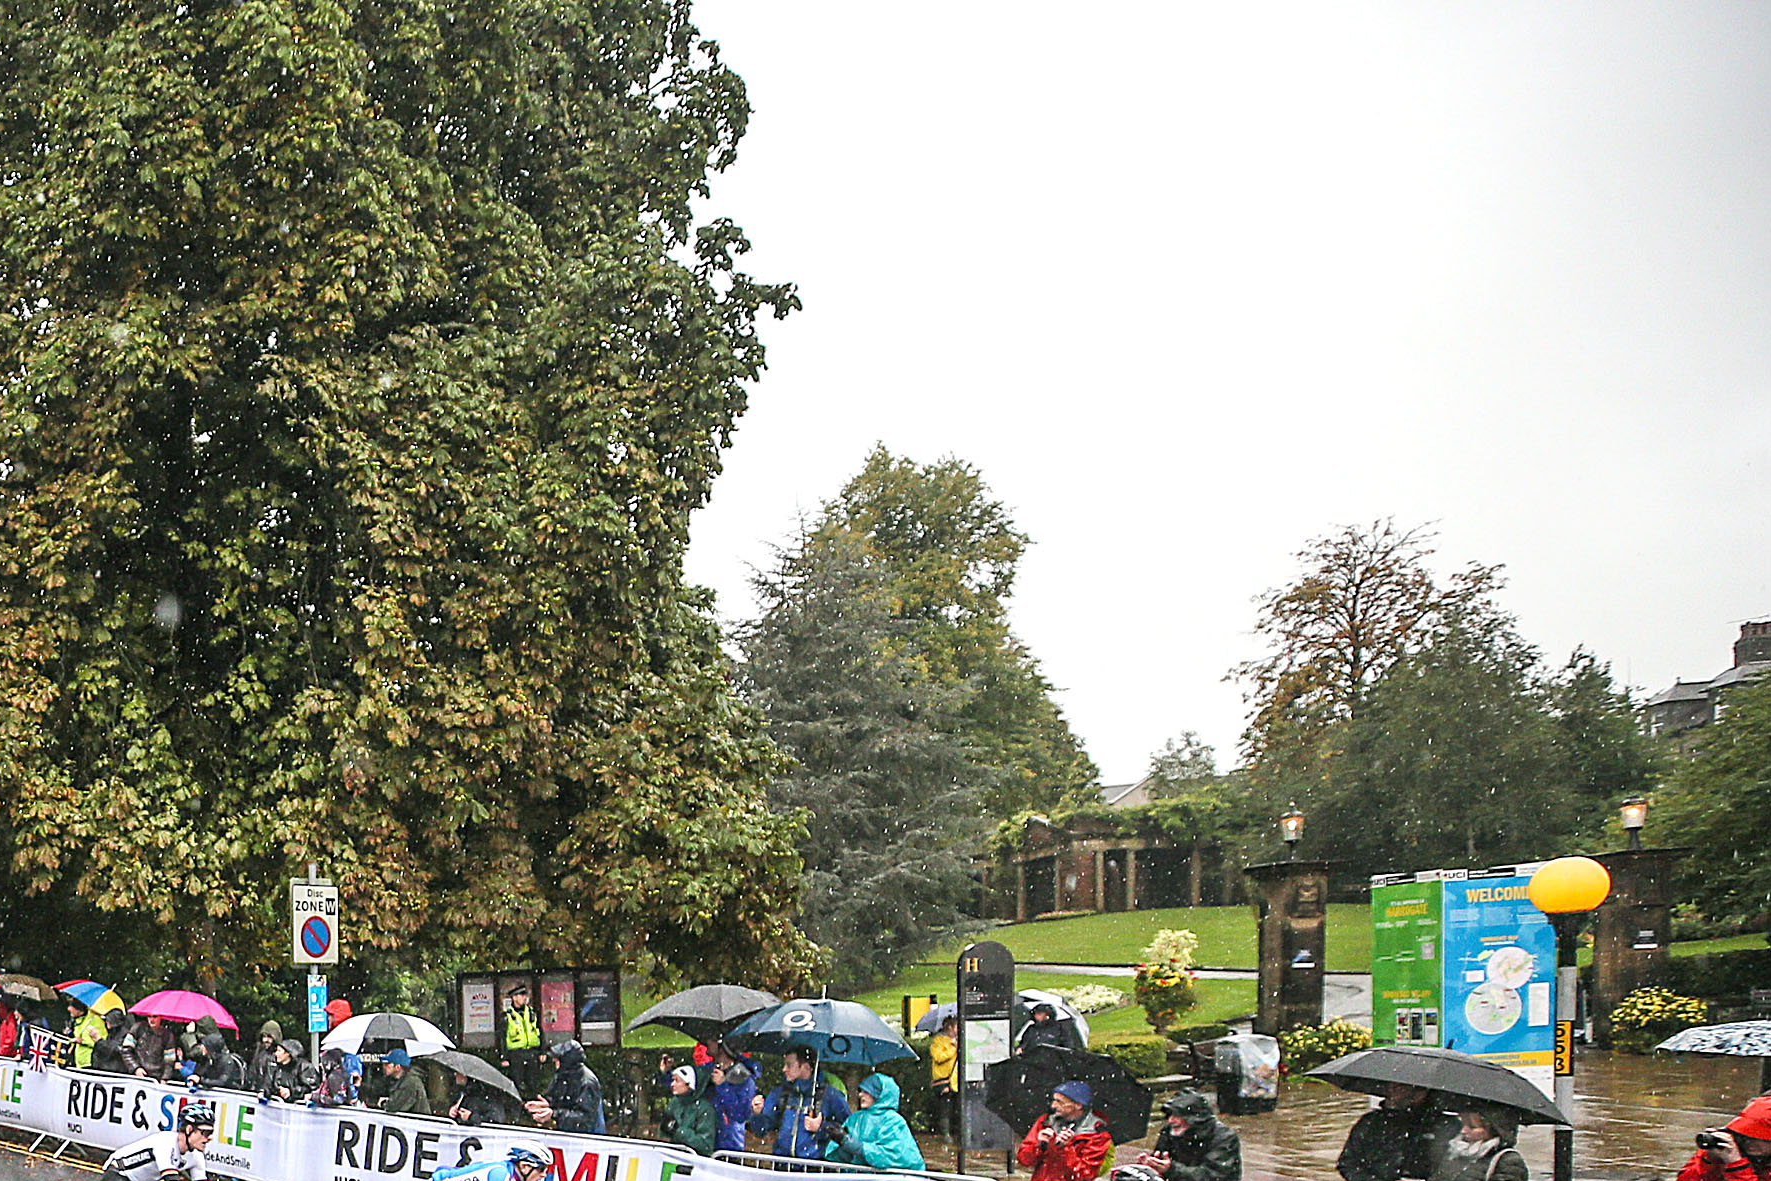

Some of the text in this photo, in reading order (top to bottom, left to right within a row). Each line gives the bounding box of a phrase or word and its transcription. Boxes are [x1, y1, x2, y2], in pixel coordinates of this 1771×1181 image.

[1449, 871, 1466, 880] UCI
[307, 888, 324, 898] Disc
[295, 900, 336, 914] ZONE W
[965, 957, 980, 973] H
[67, 1079, 255, 1149] RIDE & SLE
[335, 1120, 441, 1180] RIDE
